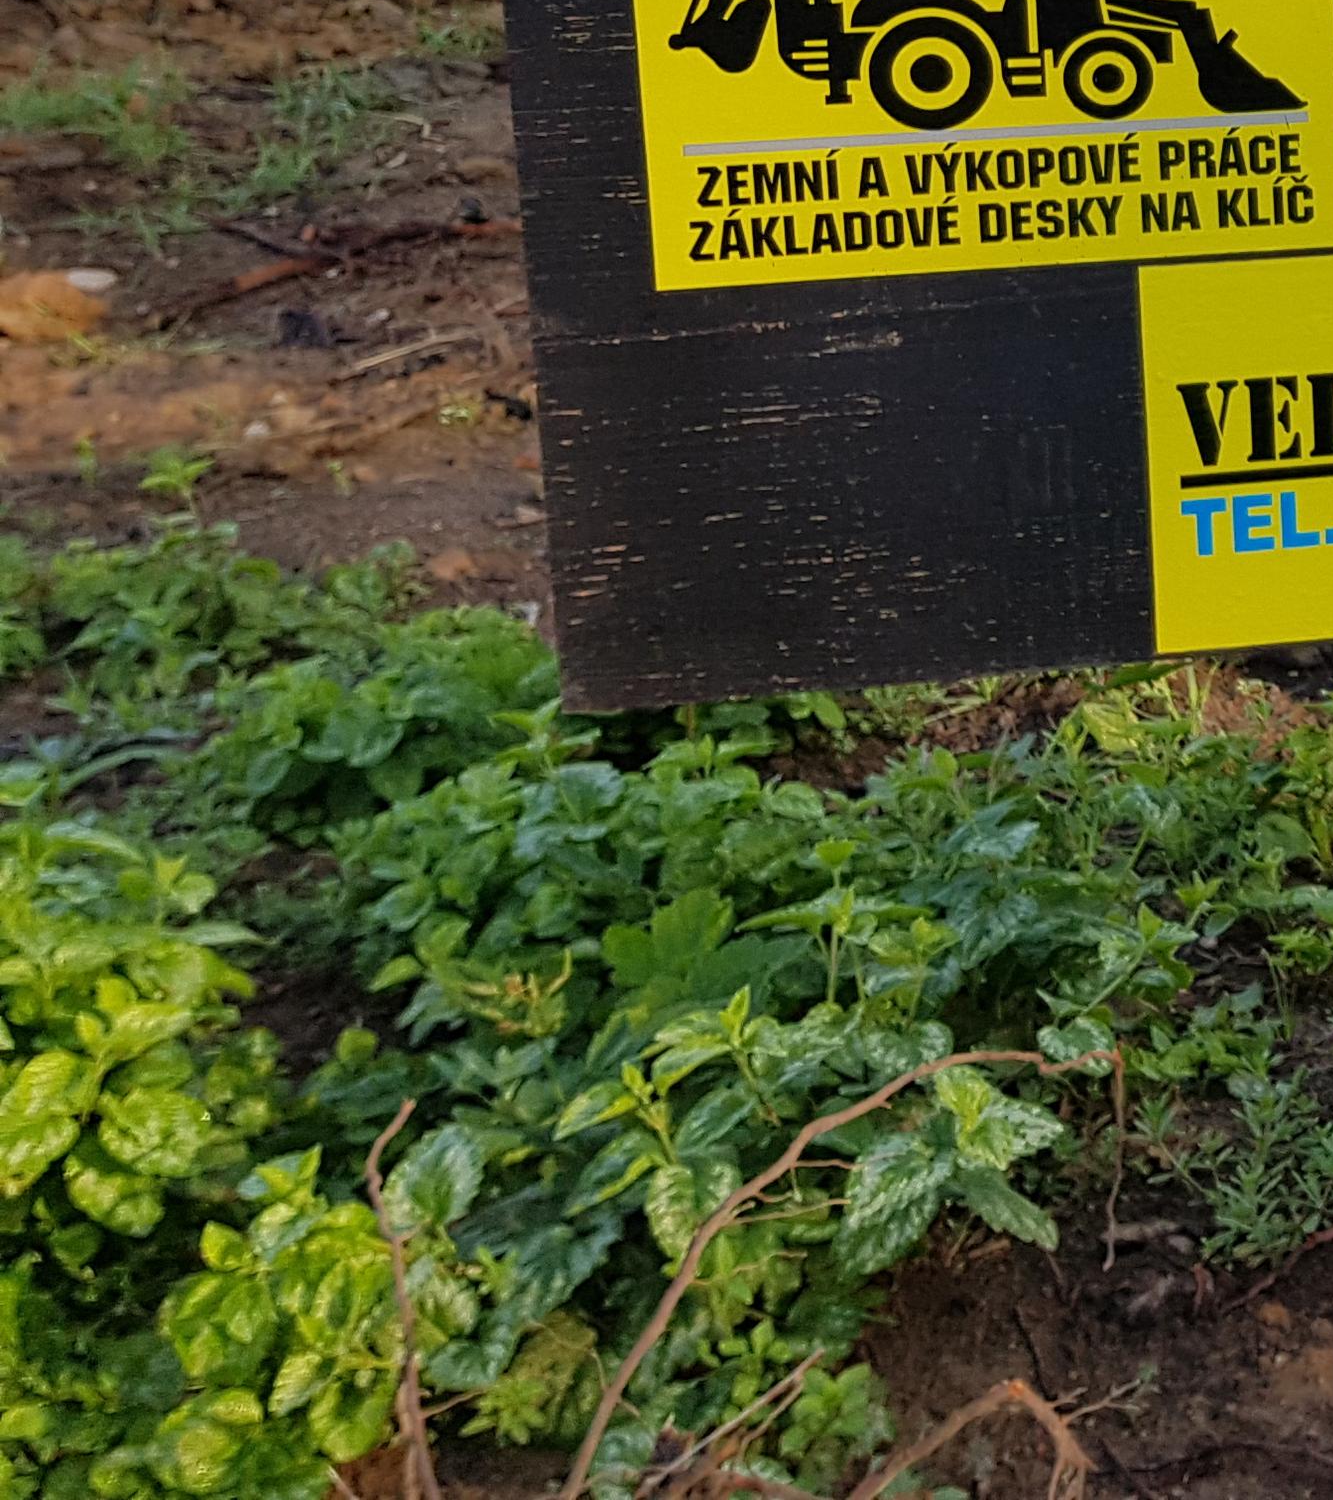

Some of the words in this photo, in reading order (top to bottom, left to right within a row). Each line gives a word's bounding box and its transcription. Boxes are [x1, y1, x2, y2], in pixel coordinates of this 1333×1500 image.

[697, 149, 839, 207] ZEMNÍ
[859, 157, 890, 197] A
[907, 133, 1141, 194] VÝKOPOVÉ
[1159, 129, 1302, 179] PRÁCE
[689, 197, 960, 262] ZÁKLADOVÉ
[980, 195, 1122, 244] DESKY
[1141, 191, 1201, 232] NA
[1218, 175, 1315, 228] KLÍČ
